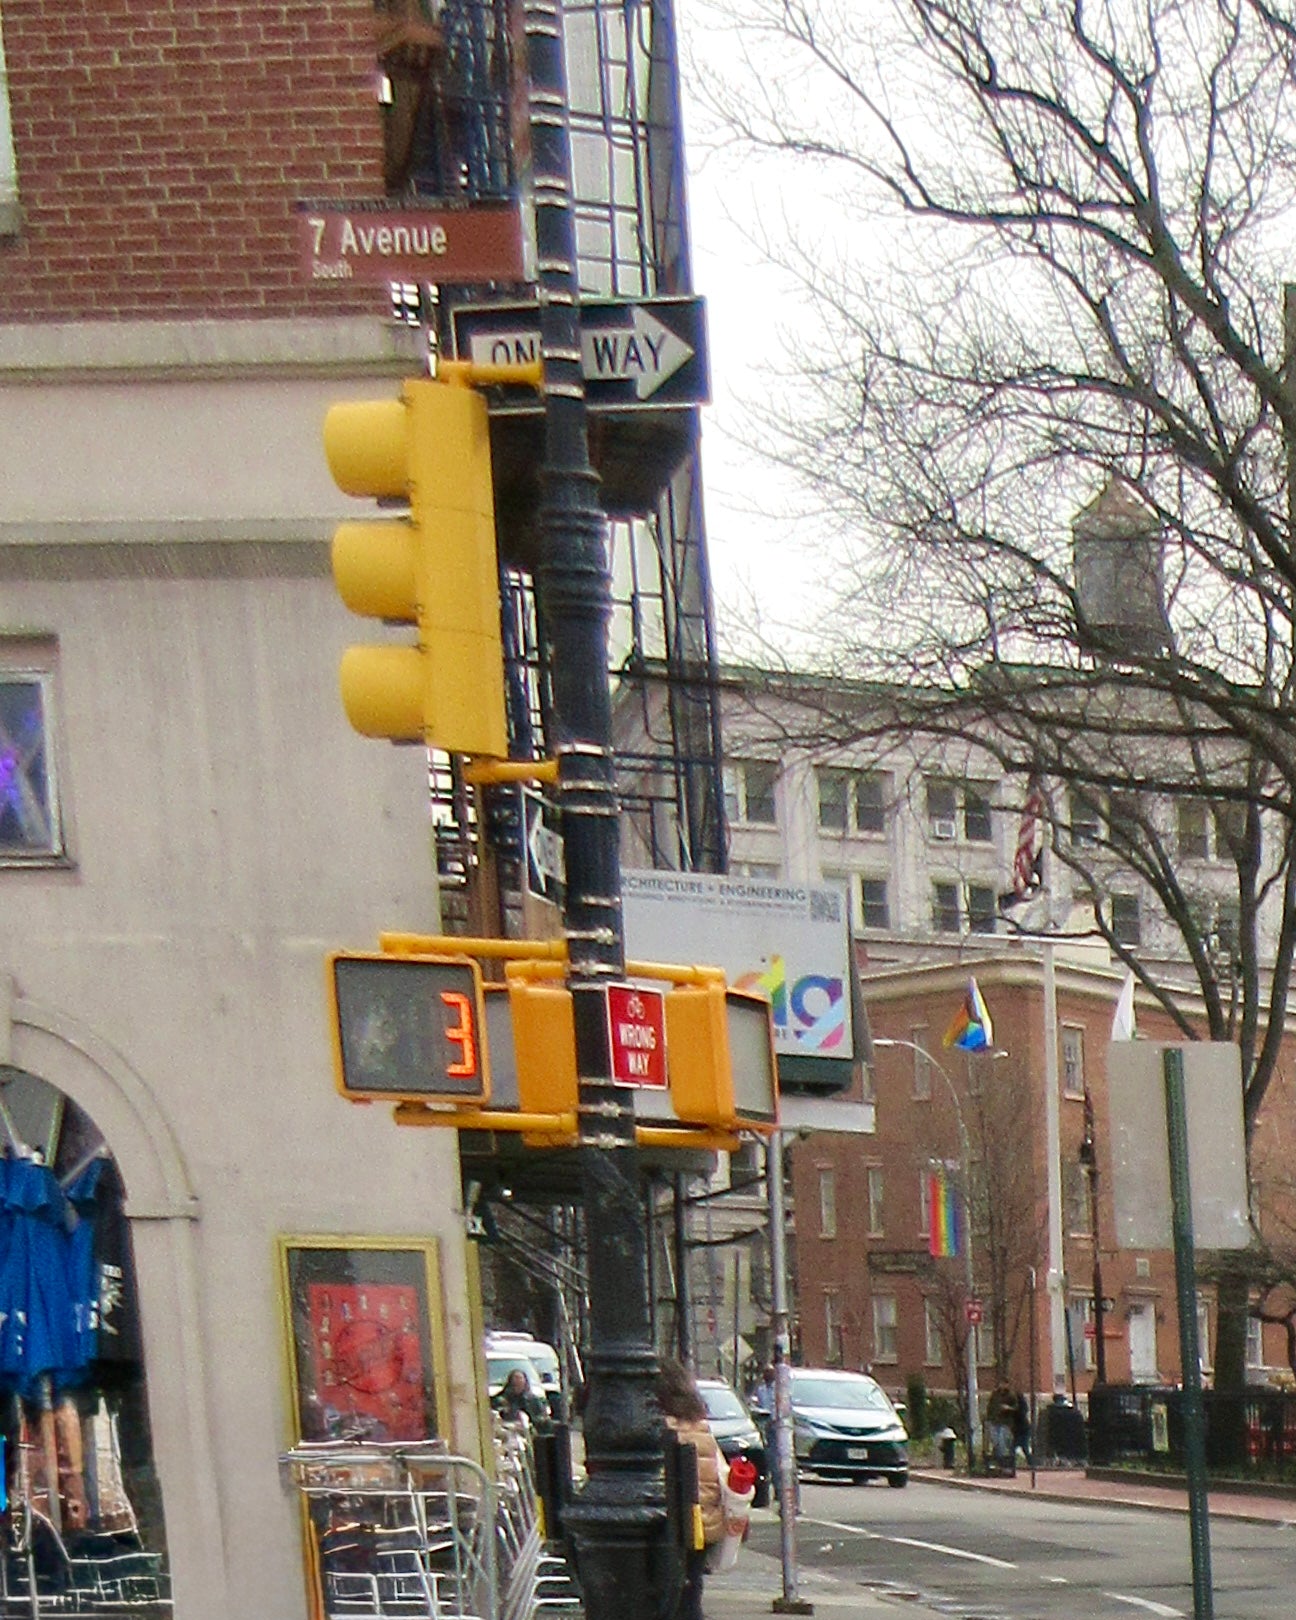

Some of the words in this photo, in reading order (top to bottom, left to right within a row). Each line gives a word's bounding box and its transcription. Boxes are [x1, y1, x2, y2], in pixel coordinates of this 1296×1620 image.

[308, 217, 326, 255] 7
[341, 219, 448, 256] Avenue
[312, 260, 353, 279] South
[492, 339, 543, 363] ON
[593, 333, 665, 374] WAY
[621, 876, 703, 894] RCHITECTURE
[719, 884, 807, 901] ENGINEERING
[440, 991, 476, 1077] 3
[618, 1023, 656, 1049] WRONG
[627, 1051, 650, 1076] WAY
